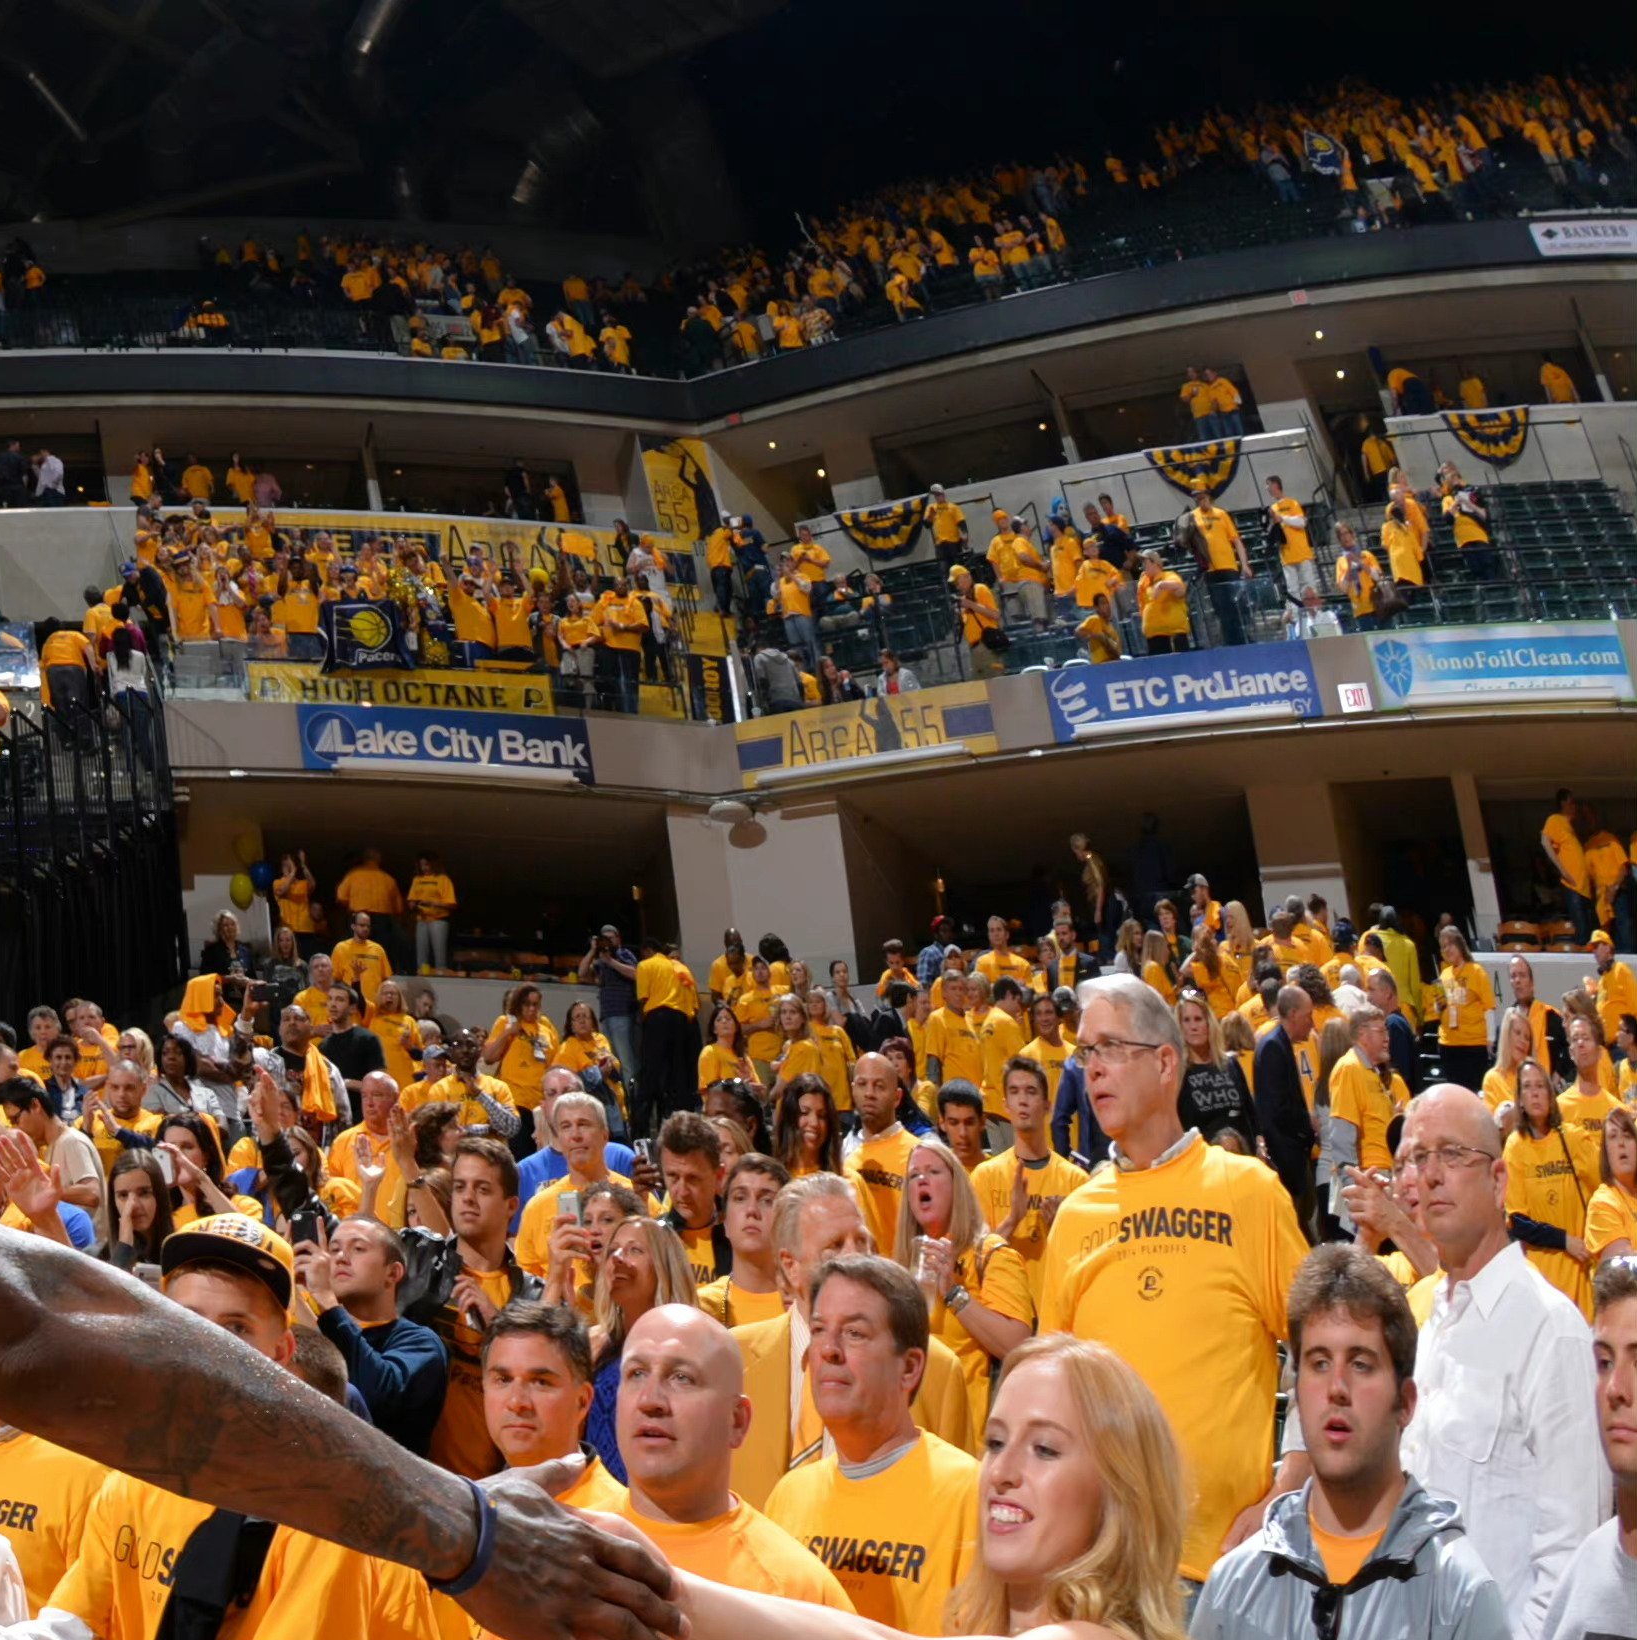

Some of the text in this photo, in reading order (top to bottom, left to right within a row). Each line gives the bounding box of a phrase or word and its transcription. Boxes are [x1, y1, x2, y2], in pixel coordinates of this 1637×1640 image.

[656, 501, 690, 534] 55
[1416, 647, 1620, 673] MonoFoilClean.com
[301, 677, 508, 710] HIGH OCTANE
[1106, 668, 1309, 712] ETC ProLiance
[1345, 687, 1368, 701] EXIT
[314, 717, 590, 769] Lake City Bank
[899, 704, 943, 748] 55
[1493, 969, 1504, 1004] 4
[806, 1535, 926, 1583] SWAGGER
